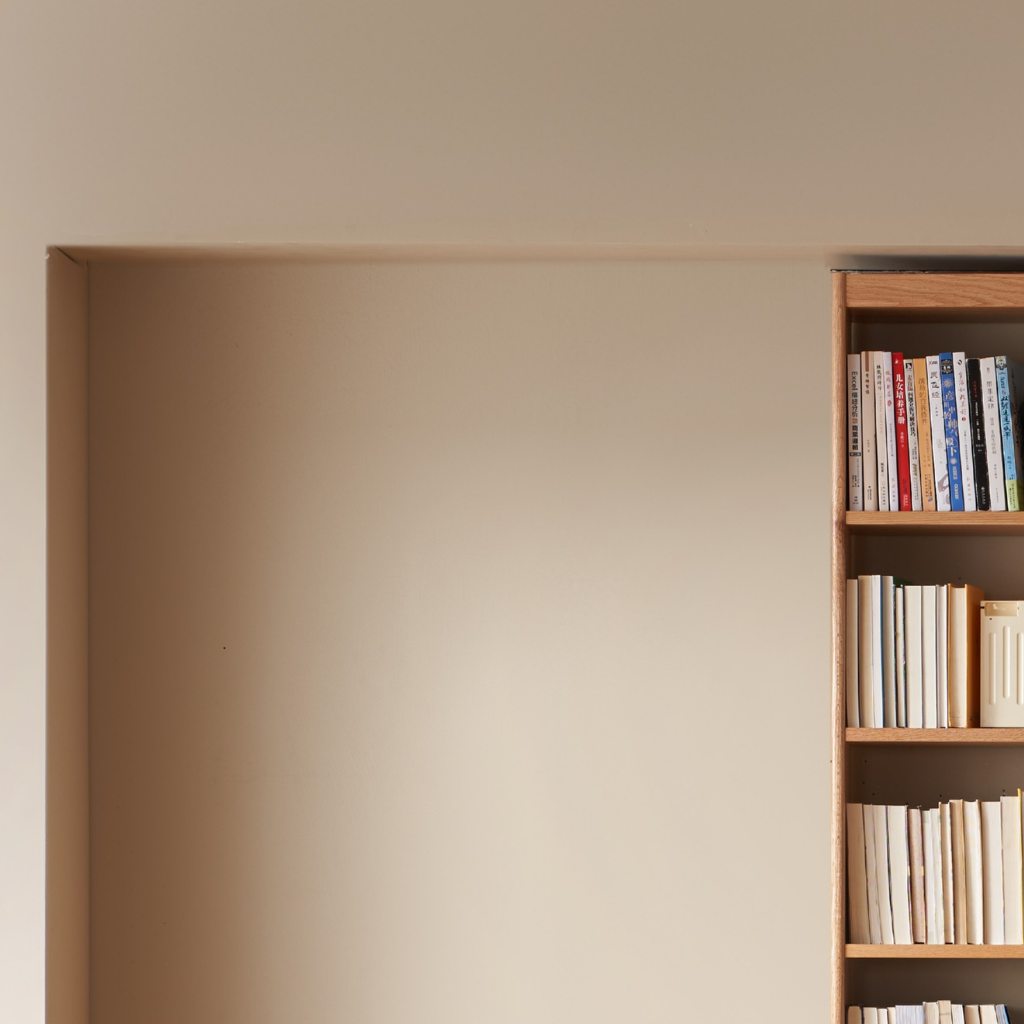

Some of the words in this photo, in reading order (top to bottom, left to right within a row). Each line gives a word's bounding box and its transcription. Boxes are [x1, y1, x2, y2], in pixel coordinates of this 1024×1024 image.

[895, 374, 905, 425] 儿女培养手册
